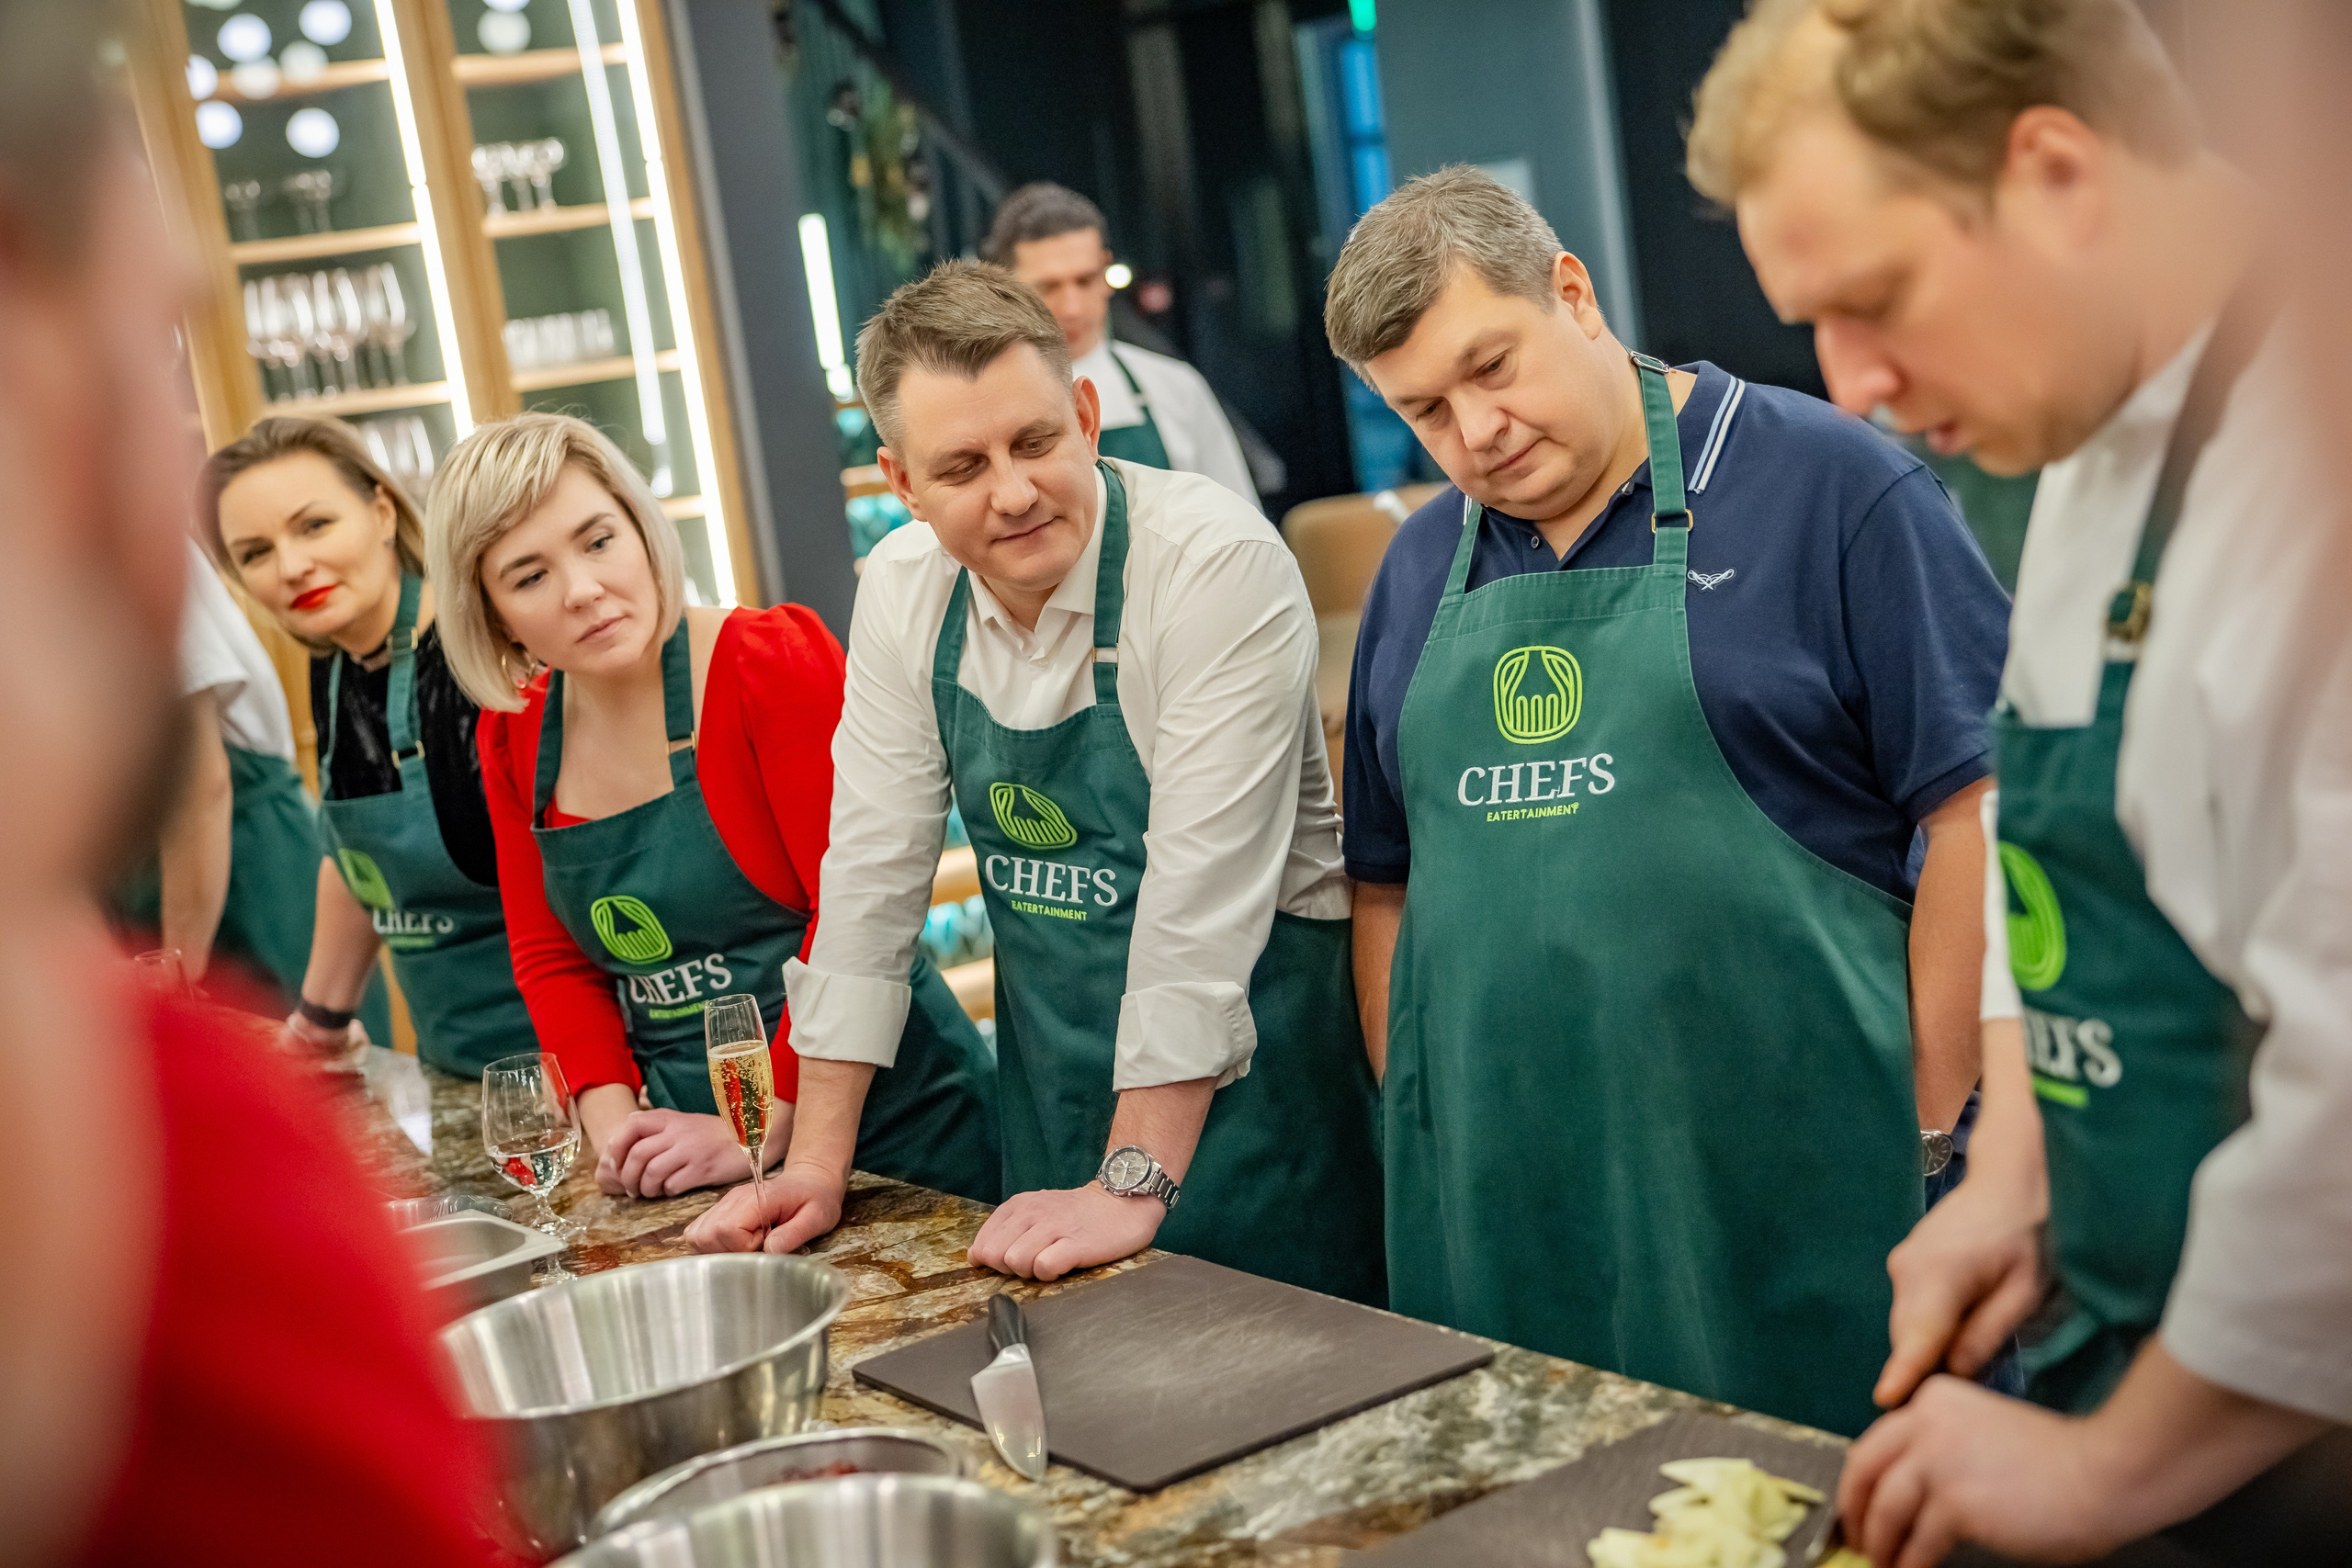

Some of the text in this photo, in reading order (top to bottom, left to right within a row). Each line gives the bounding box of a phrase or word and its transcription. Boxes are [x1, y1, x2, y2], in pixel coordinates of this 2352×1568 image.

[1457, 752, 1616, 806] CHEFS
[1487, 802, 1580, 822] EATERTAINMENT
[985, 854, 1119, 907] CHEFS
[1012, 899, 1088, 921] EATERTAINMENT
